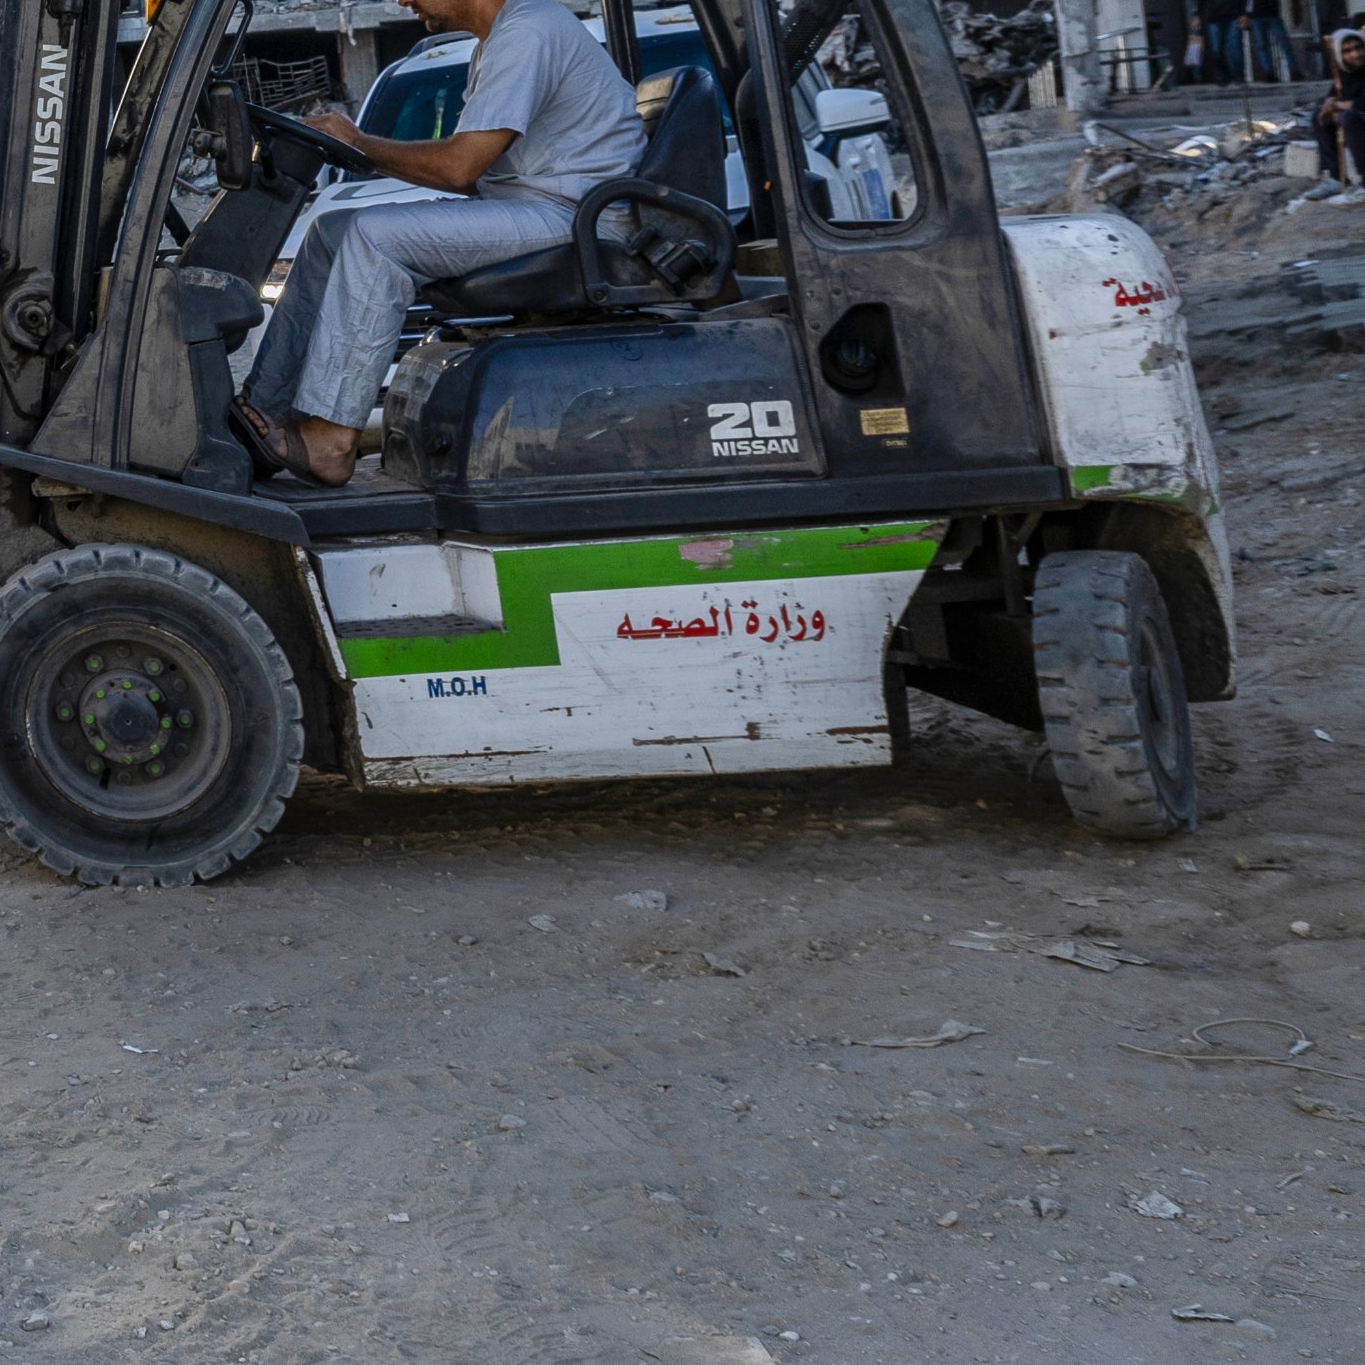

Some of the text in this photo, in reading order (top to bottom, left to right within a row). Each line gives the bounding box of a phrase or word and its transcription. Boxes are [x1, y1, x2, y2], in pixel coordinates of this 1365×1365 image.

[31, 44, 68, 185] NISSAN
[707, 400, 797, 440] 20
[711, 438, 800, 457] NISSAN
[742, 599, 826, 643] وزارة
[427, 675, 488, 699] M.O.H
